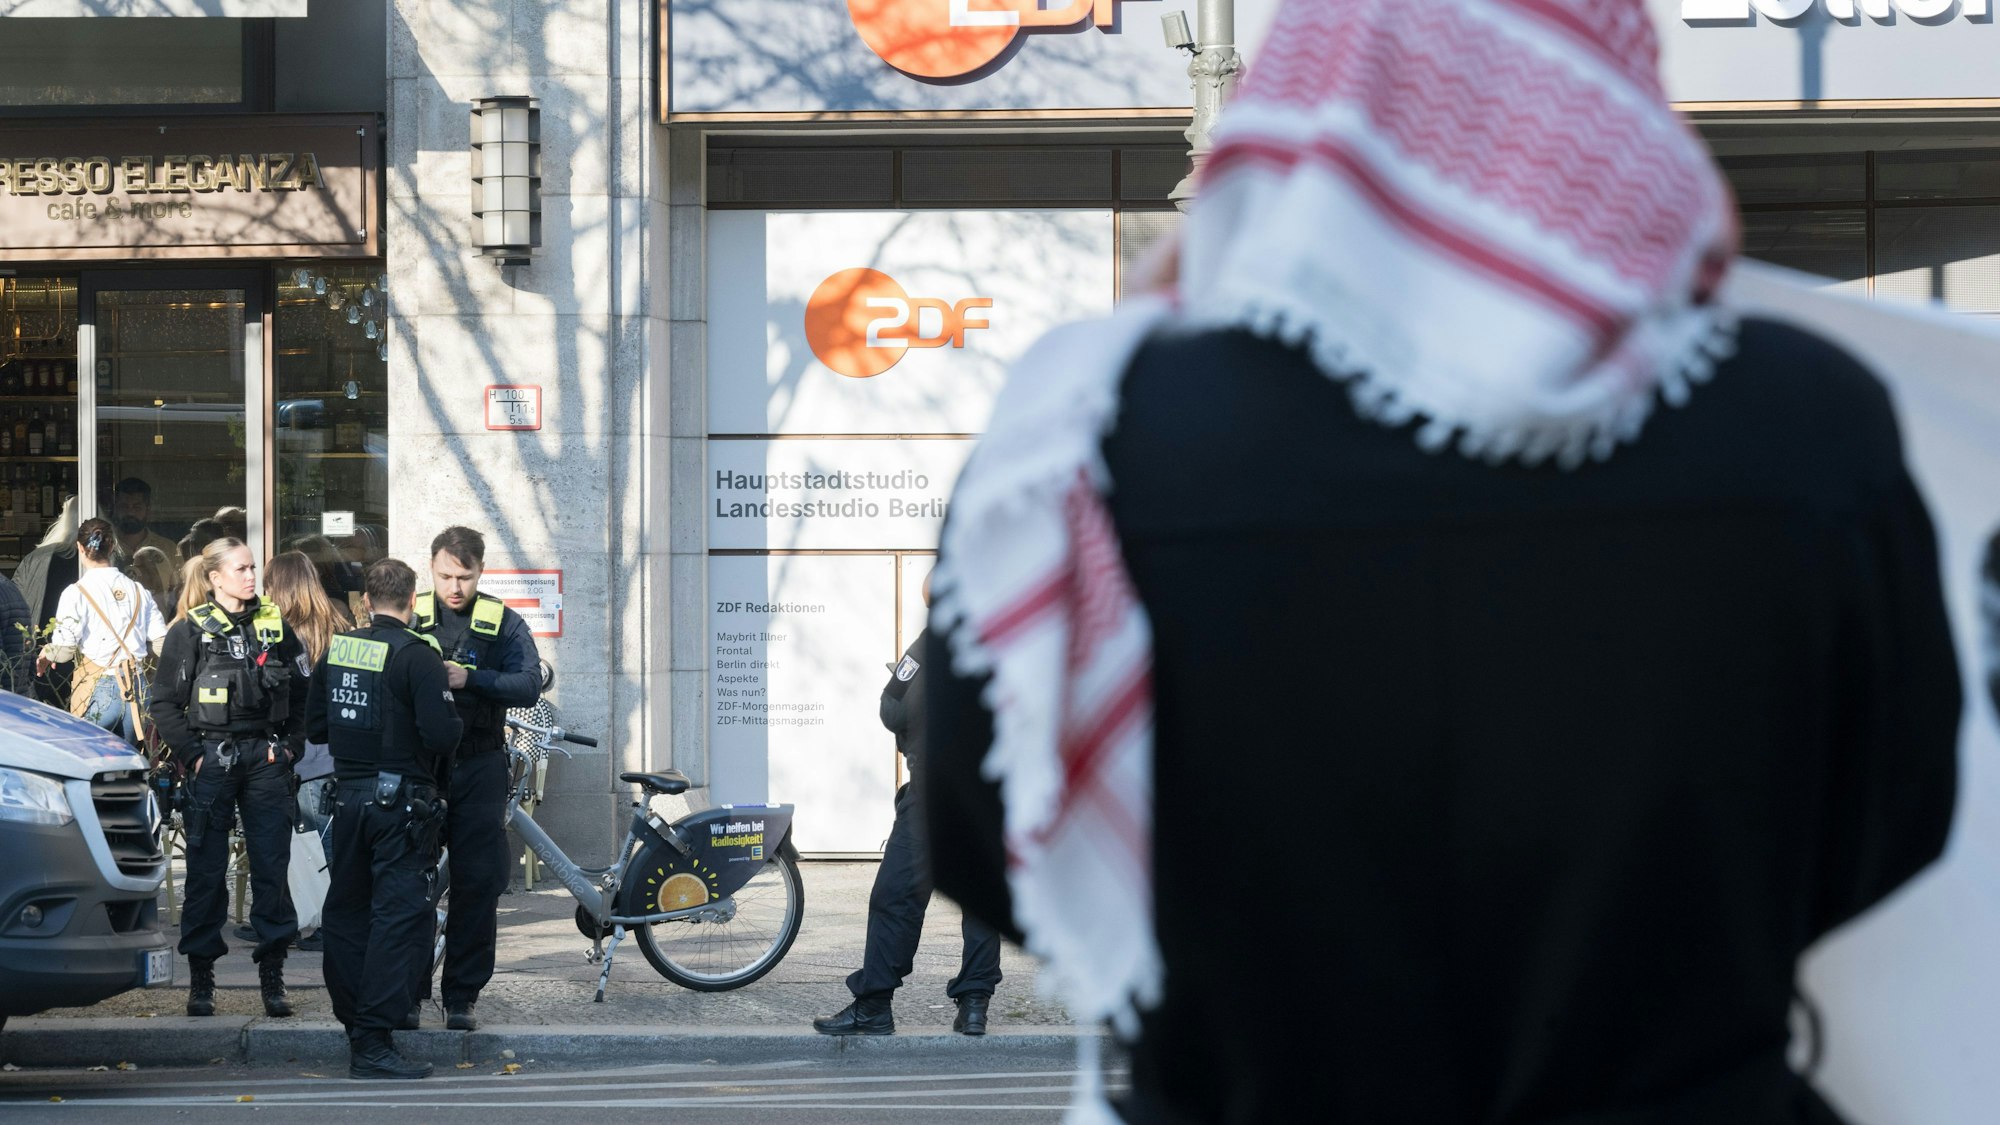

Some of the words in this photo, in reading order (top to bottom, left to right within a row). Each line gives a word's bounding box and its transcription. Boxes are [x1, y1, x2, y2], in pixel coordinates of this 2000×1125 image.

[121, 152, 324, 193] ELEGANZA
[47, 197, 97, 220] cafe
[104, 197, 122, 219] &
[130, 199, 192, 219] more
[866, 297, 993, 348] ZDF
[490, 390, 497, 399] H
[505, 390, 524, 399] 100
[716, 470, 929, 494] Hauptstadtstudio
[716, 498, 879, 518] Landesstudio
[889, 498, 949, 518] Berli
[478, 578, 555, 586] öschwassereinspeisung
[717, 602, 742, 613] ZDF
[745, 602, 825, 613] Redaktionen
[717, 632, 756, 643] Maybrit
[760, 632, 787, 641] Illner
[329, 639, 386, 670] POLIZEI
[717, 646, 752, 655] Frontal
[717, 660, 746, 669] Berlin
[750, 660, 780, 669] direkt
[342, 672, 359, 688] BE
[717, 674, 759, 684] Aspekte
[331, 688, 368, 706] 15212
[717, 688, 738, 697] Was
[742, 688, 766, 697] nun?
[717, 702, 825, 712] ZDF-Morgenmagazin
[717, 716, 824, 727] ZDF-Mittagsmagazin
[710, 823, 725, 835] Wir
[726, 822, 751, 834] helfen
[752, 820, 765, 832] bei
[711, 833, 764, 848] Radlosigkeit!
[534, 842, 584, 895] nextbike
